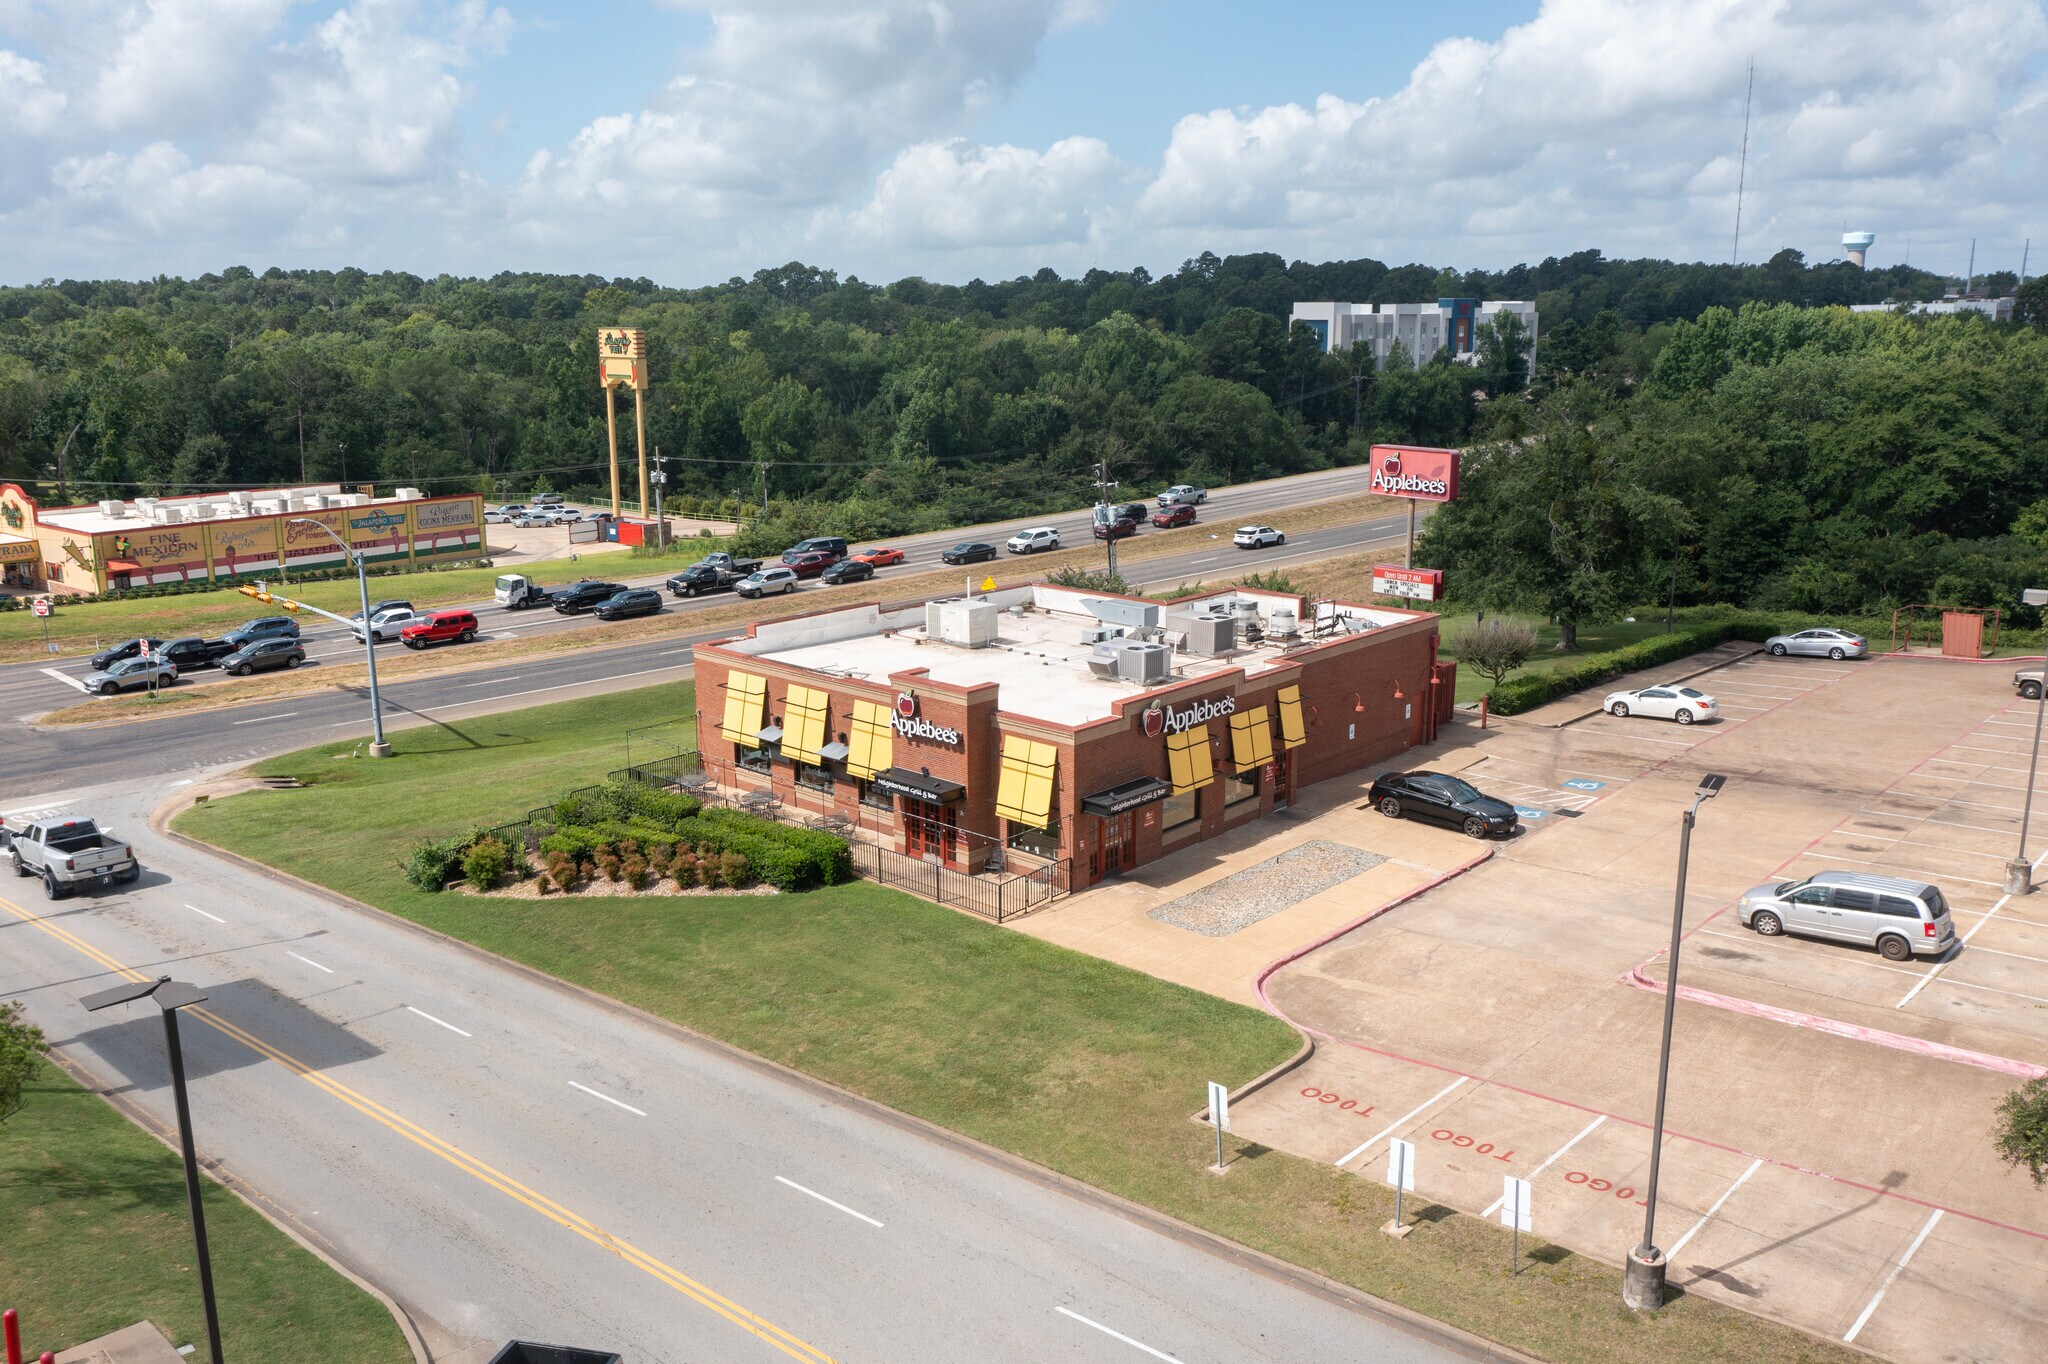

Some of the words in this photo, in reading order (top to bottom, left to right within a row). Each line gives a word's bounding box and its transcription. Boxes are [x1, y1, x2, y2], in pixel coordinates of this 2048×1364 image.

[1372, 468, 1446, 494] Applebee's
[389, 515, 403, 523] TREE
[419, 517, 440, 526] COCINA
[442, 513, 473, 523] MEXICANA
[150, 533, 181, 544] FINE
[132, 542, 198, 557] MEXICAN
[256, 552, 278, 561] THE
[352, 540, 378, 549] TREE
[1384, 571, 1396, 579] Open
[1163, 695, 1235, 735] Applebee's
[889, 708, 958, 744] Applebee's
[877, 778, 910, 792] Neighborhood
[927, 791, 938, 800] Bar
[1110, 796, 1141, 813] Neighborhood
[1141, 791, 1153, 802] Grill
[1157, 788, 1166, 796] Bar
